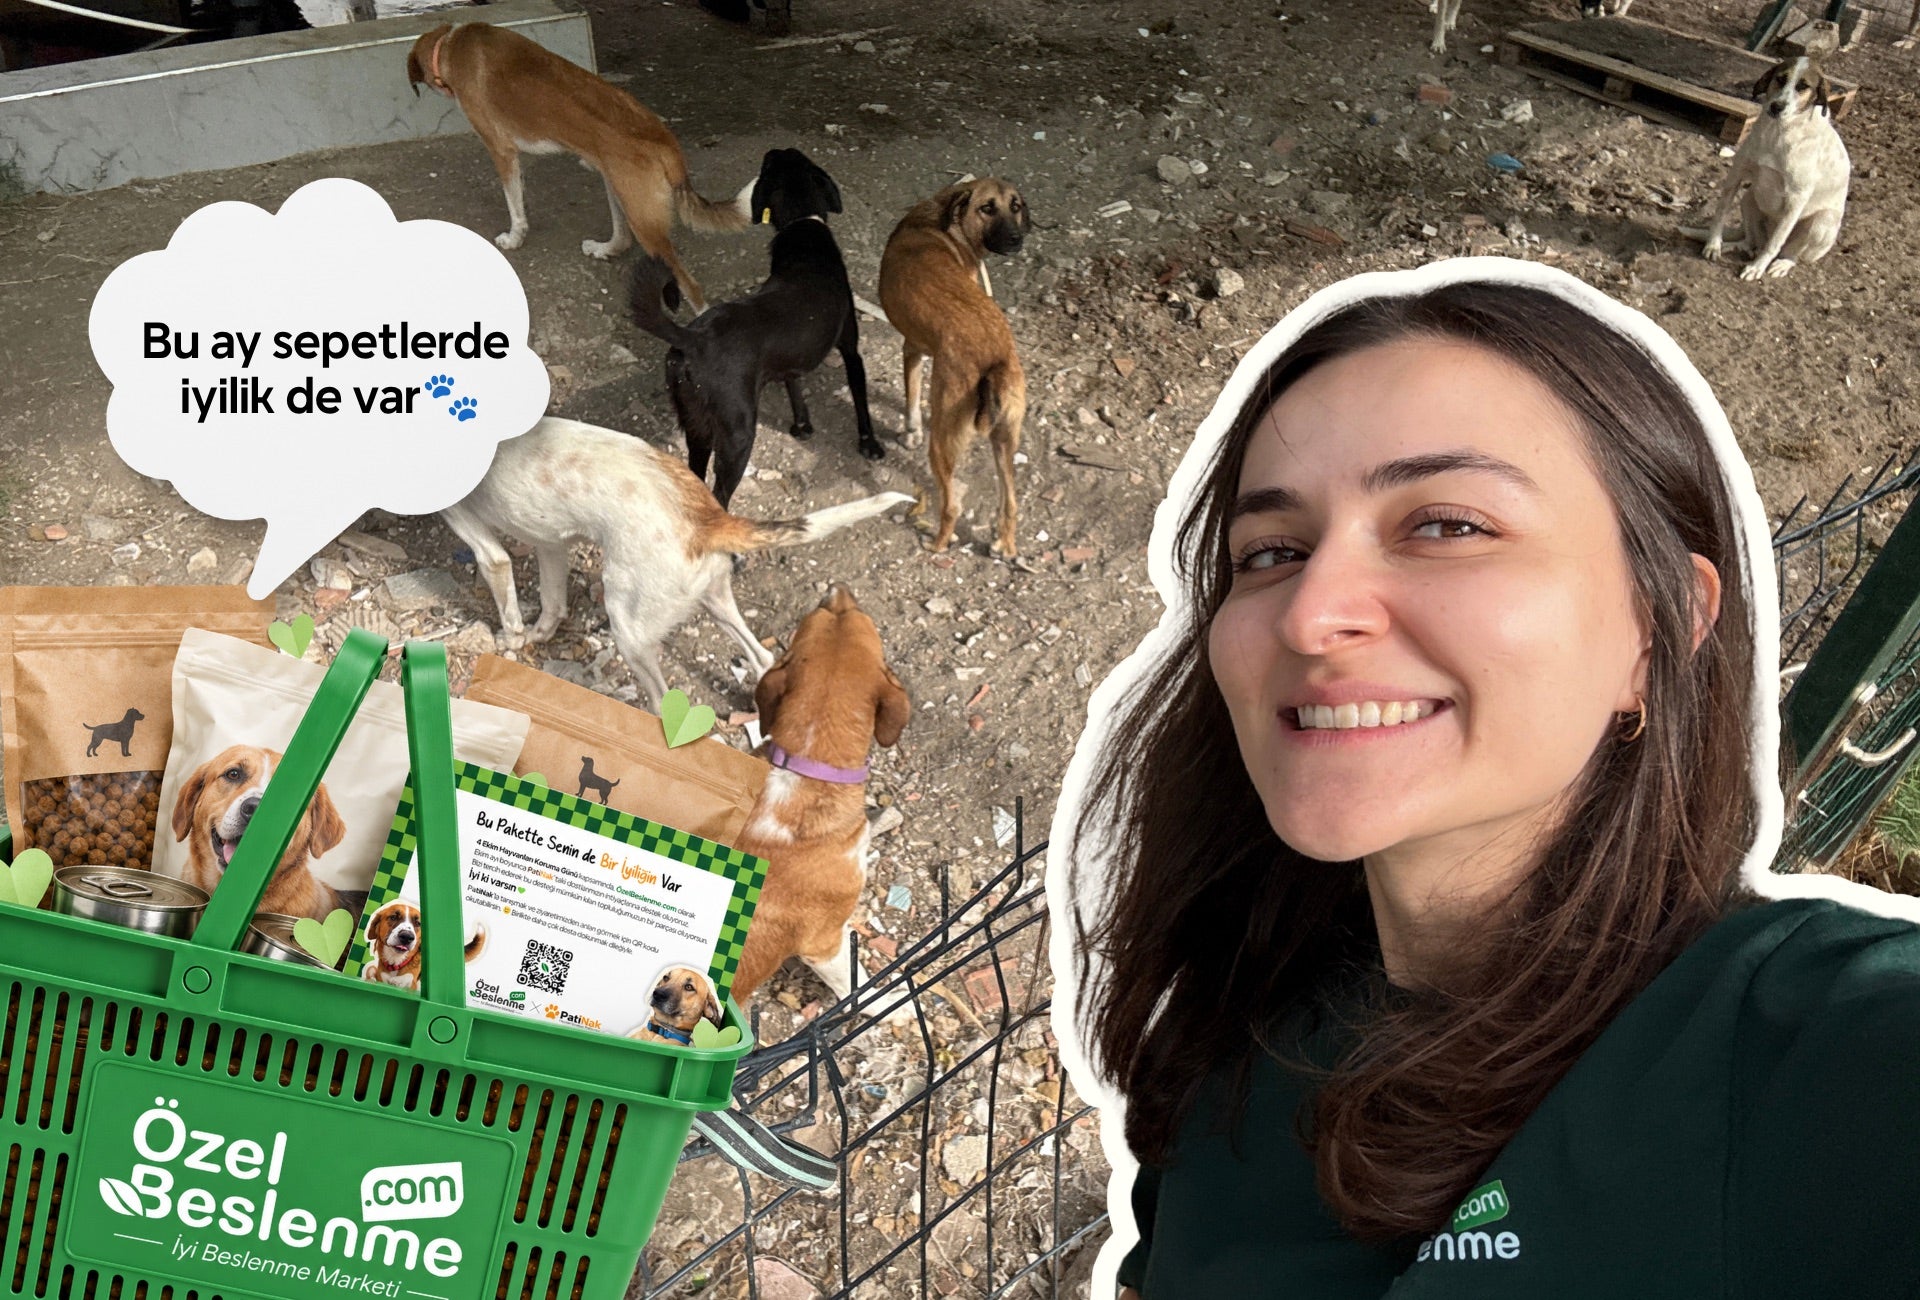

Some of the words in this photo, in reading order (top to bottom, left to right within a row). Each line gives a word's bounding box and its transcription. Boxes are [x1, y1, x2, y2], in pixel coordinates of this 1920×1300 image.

[476, 810, 494, 829] Bu
[495, 817, 545, 846] Pakette
[546, 834, 580, 858] Senin
[581, 847, 597, 864] de
[599, 852, 619, 871] Bir
[619, 856, 659, 886] İyiliğin
[660, 873, 683, 893] Var
[468, 866, 481, 881] İyi
[480, 872, 490, 883] ki
[490, 877, 517, 892] varsın
[471, 858, 483, 867] Bizi
[482, 862, 501, 873] tercih
[500, 868, 523, 881] ederek
[522, 875, 532, 884] bu
[532, 879, 556, 893] desteği
[646, 917, 655, 926] bir
[654, 922, 677, 934] parçası
[473, 848, 490, 859] Ekim
[489, 854, 499, 863] ayı
[498, 856, 527, 872] boyunca
[640, 905, 662, 918] destek
[482, 840, 499, 851] Ekim
[534, 857, 560, 872] Koruma
[560, 866, 579, 878] Günü
[615, 885, 678, 912] ÖzelBeslenme.com
[677, 908, 696, 919] olarak
[531, 916, 547, 926] daha
[547, 921, 559, 931] çok
[558, 925, 577, 936] dosta
[596, 928, 620, 940] görmek
[620, 935, 632, 944] için
[631, 939, 643, 948] QR
[642, 942, 660, 954] kodu
[475, 978, 500, 994] Özel
[476, 988, 525, 1010] Beslenme
[560, 1010, 602, 1029] PatiNak
[132, 1096, 288, 1185] Özel
[364, 1174, 457, 1207] .com
[1454, 1189, 1505, 1223] .com
[129, 1163, 463, 1278] Beslenme
[171, 1234, 200, 1260] İyi
[201, 1242, 311, 1281] Beslenme
[315, 1265, 402, 1298] Marketi
